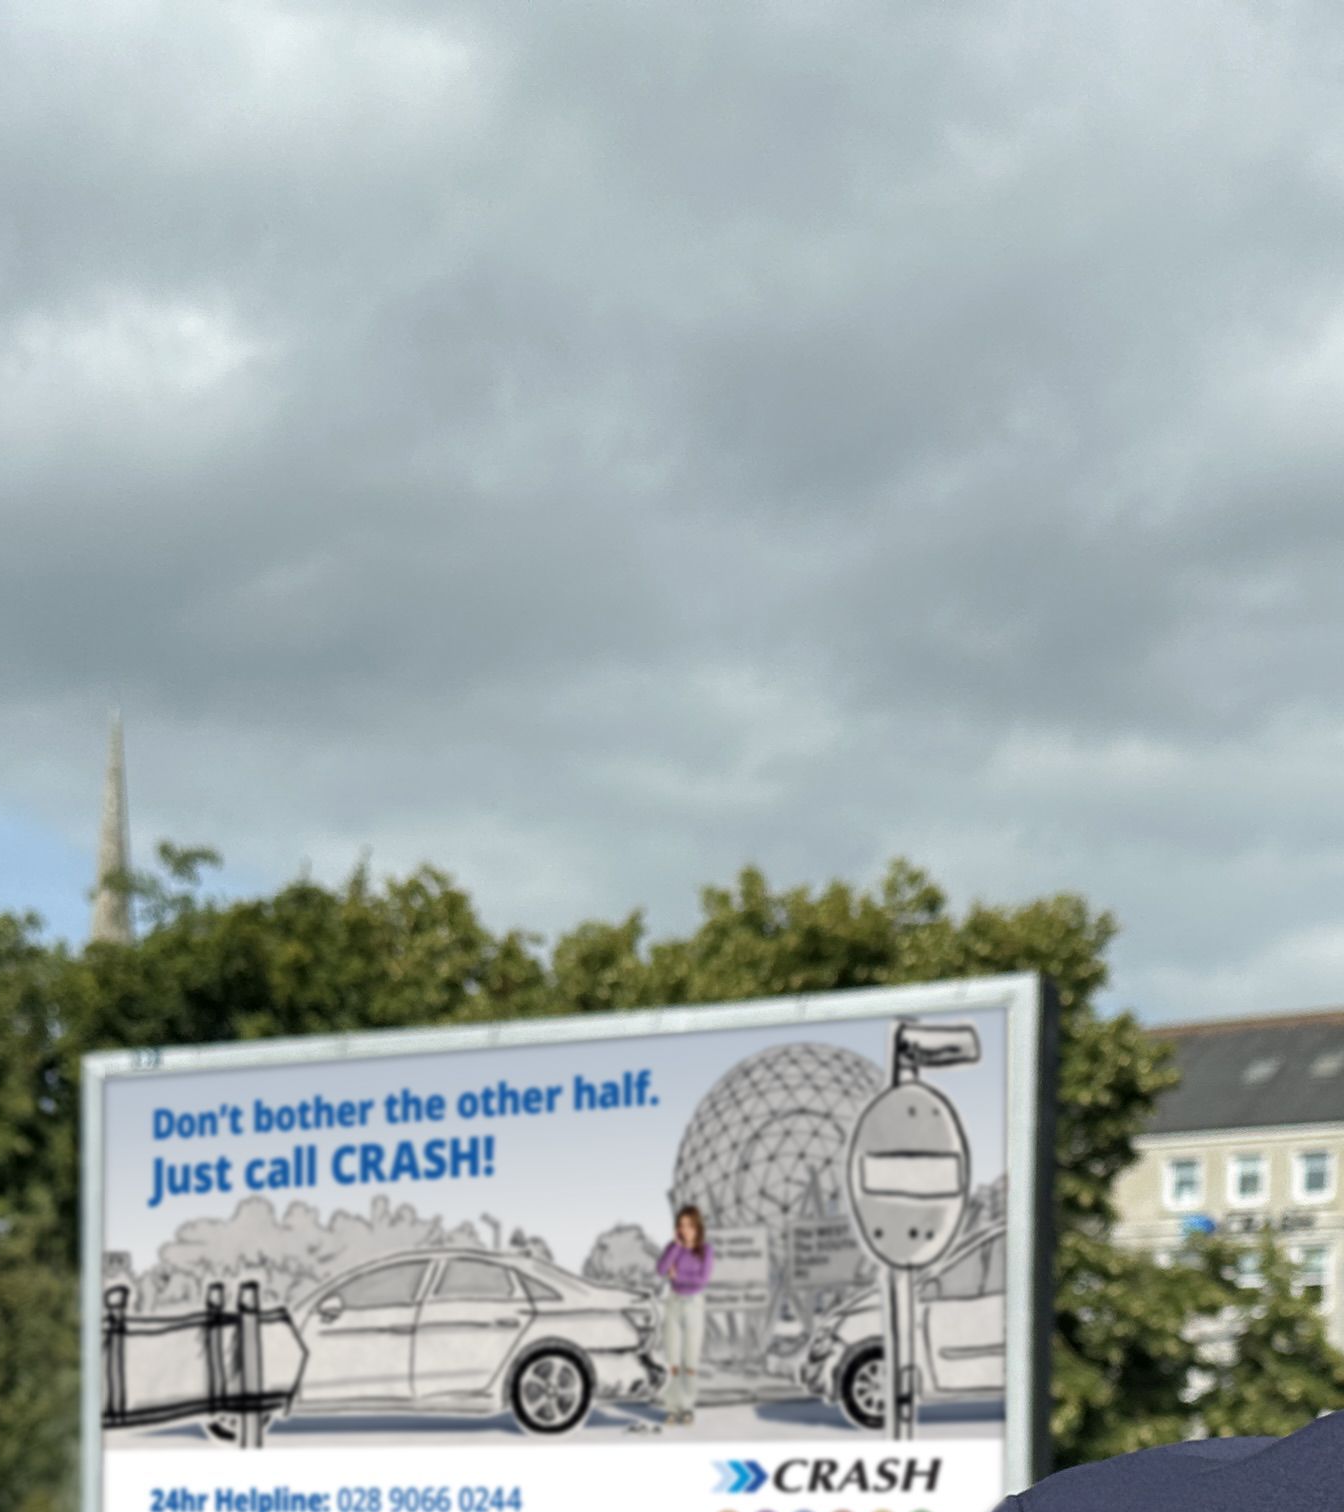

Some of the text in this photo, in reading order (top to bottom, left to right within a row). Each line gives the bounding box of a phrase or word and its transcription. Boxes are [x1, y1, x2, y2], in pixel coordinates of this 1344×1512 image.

[153, 1069, 661, 1142] Don't bother the other half.
[148, 1135, 496, 1208] Just call CRASH!
[772, 1458, 943, 1495] CRASH
